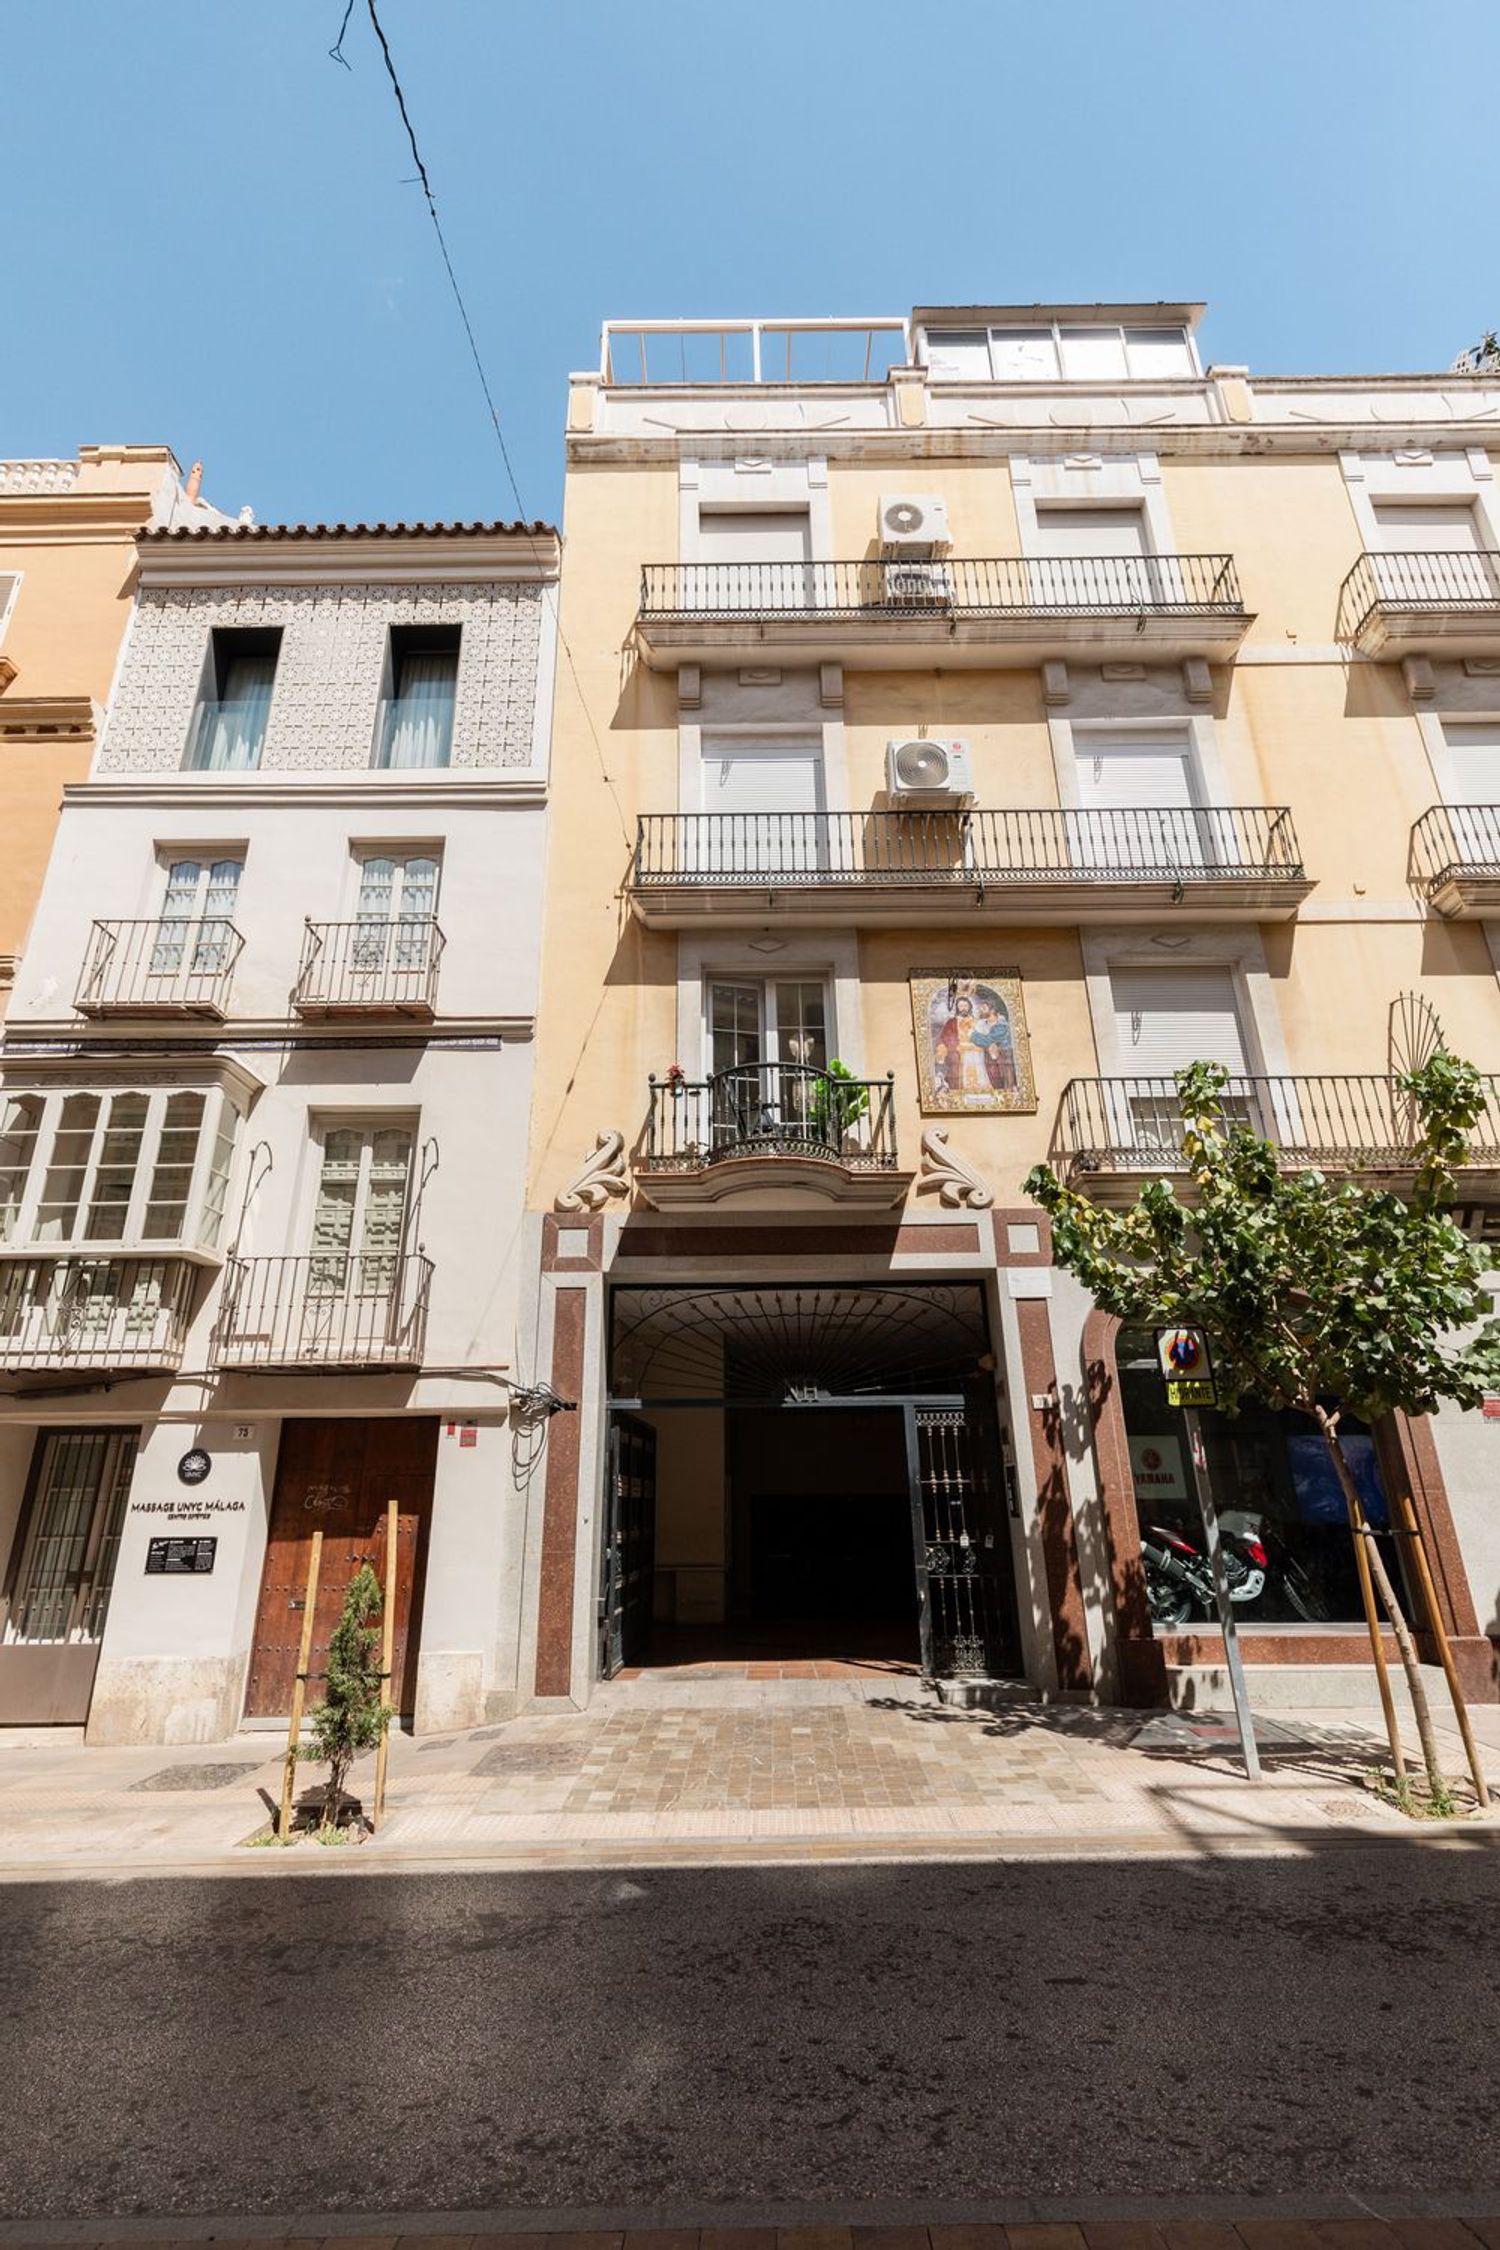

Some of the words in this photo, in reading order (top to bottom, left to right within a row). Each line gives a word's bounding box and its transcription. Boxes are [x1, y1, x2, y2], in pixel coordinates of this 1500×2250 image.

[131, 1502, 175, 1513] MASSAGE
[177, 1502, 203, 1512] UNYC
[205, 1498, 246, 1512] MÁLAGA
